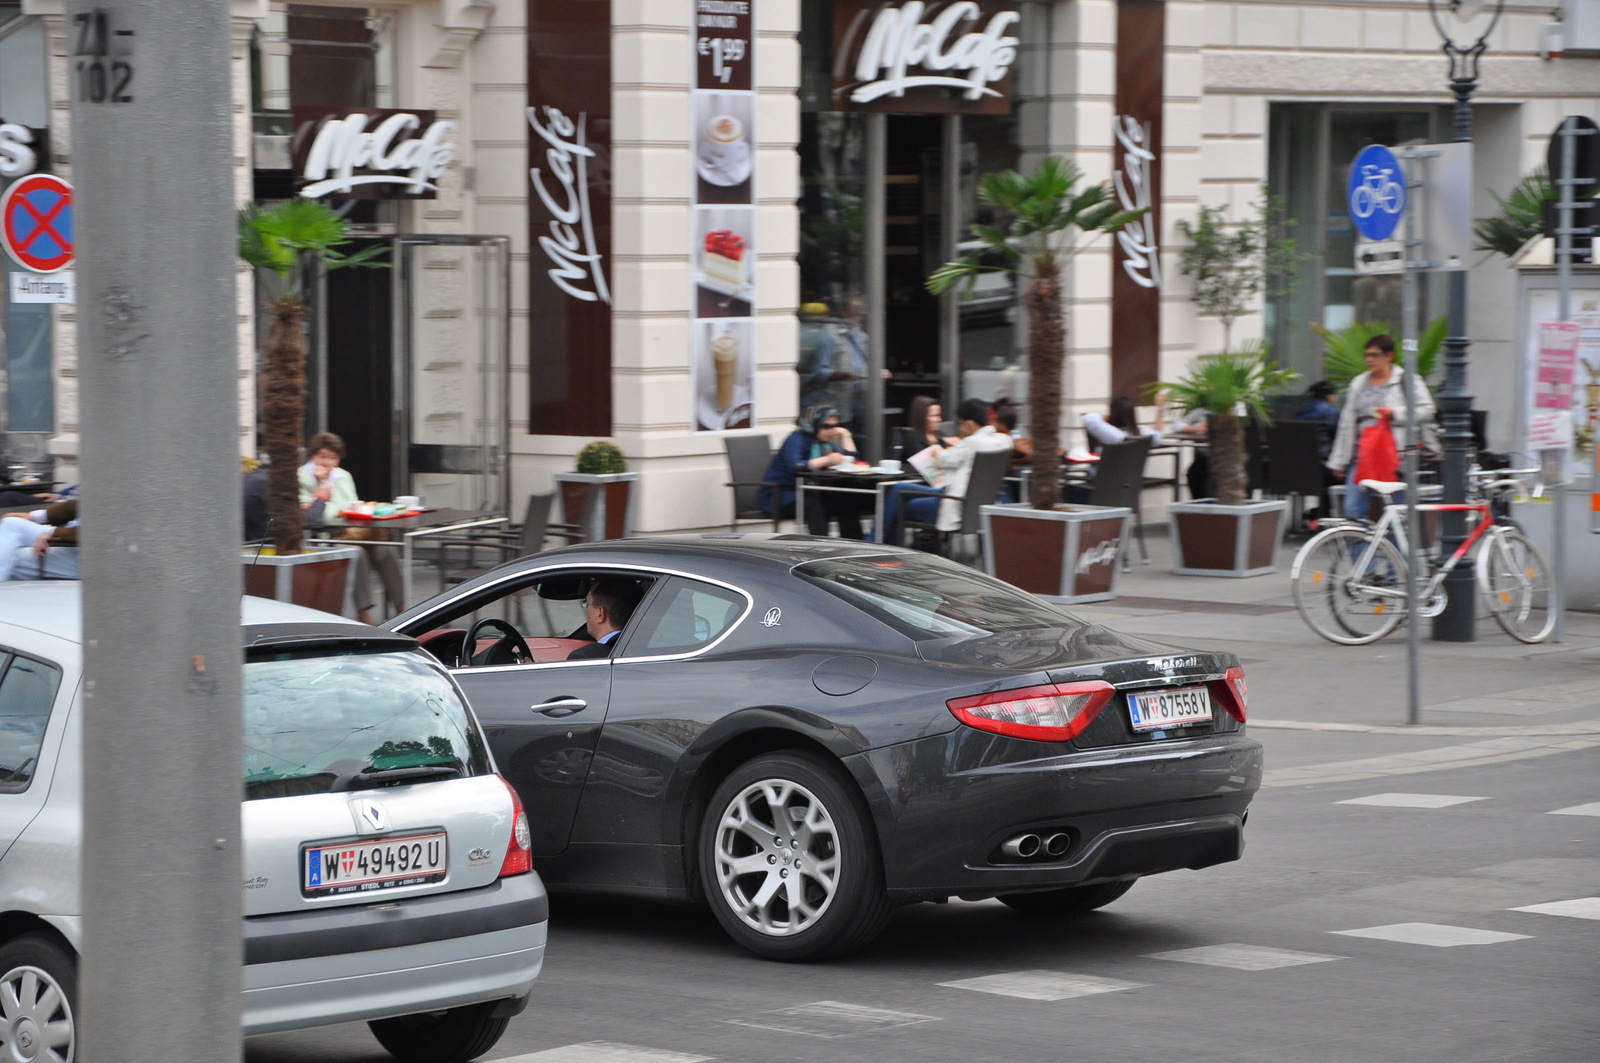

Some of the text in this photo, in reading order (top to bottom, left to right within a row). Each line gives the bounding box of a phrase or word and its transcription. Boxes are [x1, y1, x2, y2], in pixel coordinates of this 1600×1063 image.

[1139, 697, 1151, 721] W
[1160, 693, 1199, 718] 87558
[324, 839, 440, 880] W 49492 U
[311, 872, 319, 882] A
